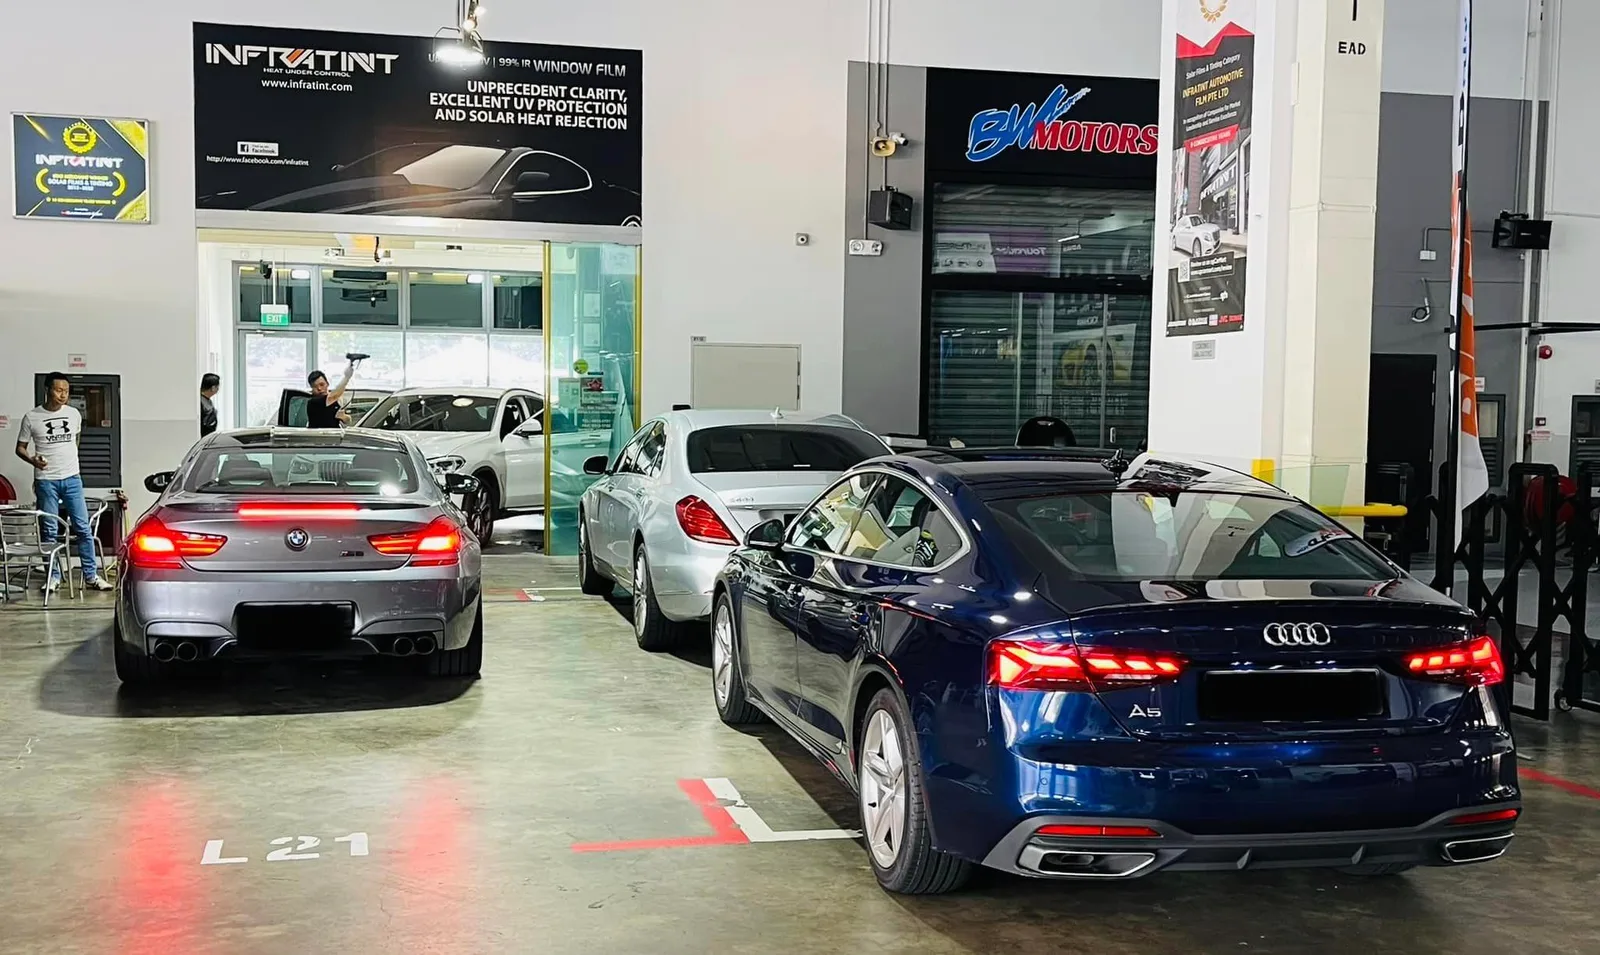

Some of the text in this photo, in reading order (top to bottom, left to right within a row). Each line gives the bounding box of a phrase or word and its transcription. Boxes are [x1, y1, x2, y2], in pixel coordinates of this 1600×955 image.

[205, 42, 399, 74] INFRATINT
[1338, 41, 1366, 55] EAD
[498, 58, 520, 69] 99%
[521, 59, 531, 70] IR
[533, 60, 593, 76] WINDOW
[596, 63, 626, 78] FILM
[1222, 53, 1241, 65] Category
[314, 70, 351, 79] CONTROL
[1182, 67, 1244, 98] INFRATINT AUTOMOTIVE
[261, 79, 353, 93] www.infratint.com
[467, 80, 628, 104] UNPRECEDENT CLARITY,
[430, 92, 628, 116] EXCELLENT UV PROTECTION
[1195, 87, 1230, 107] FILM PTE LTD
[435, 109, 628, 130] AND SOLAR HEAT REJECTION
[1030, 120, 1159, 155] MOTORS
[266, 314, 282, 323] EXIT
[1128, 703, 1162, 719] A5
